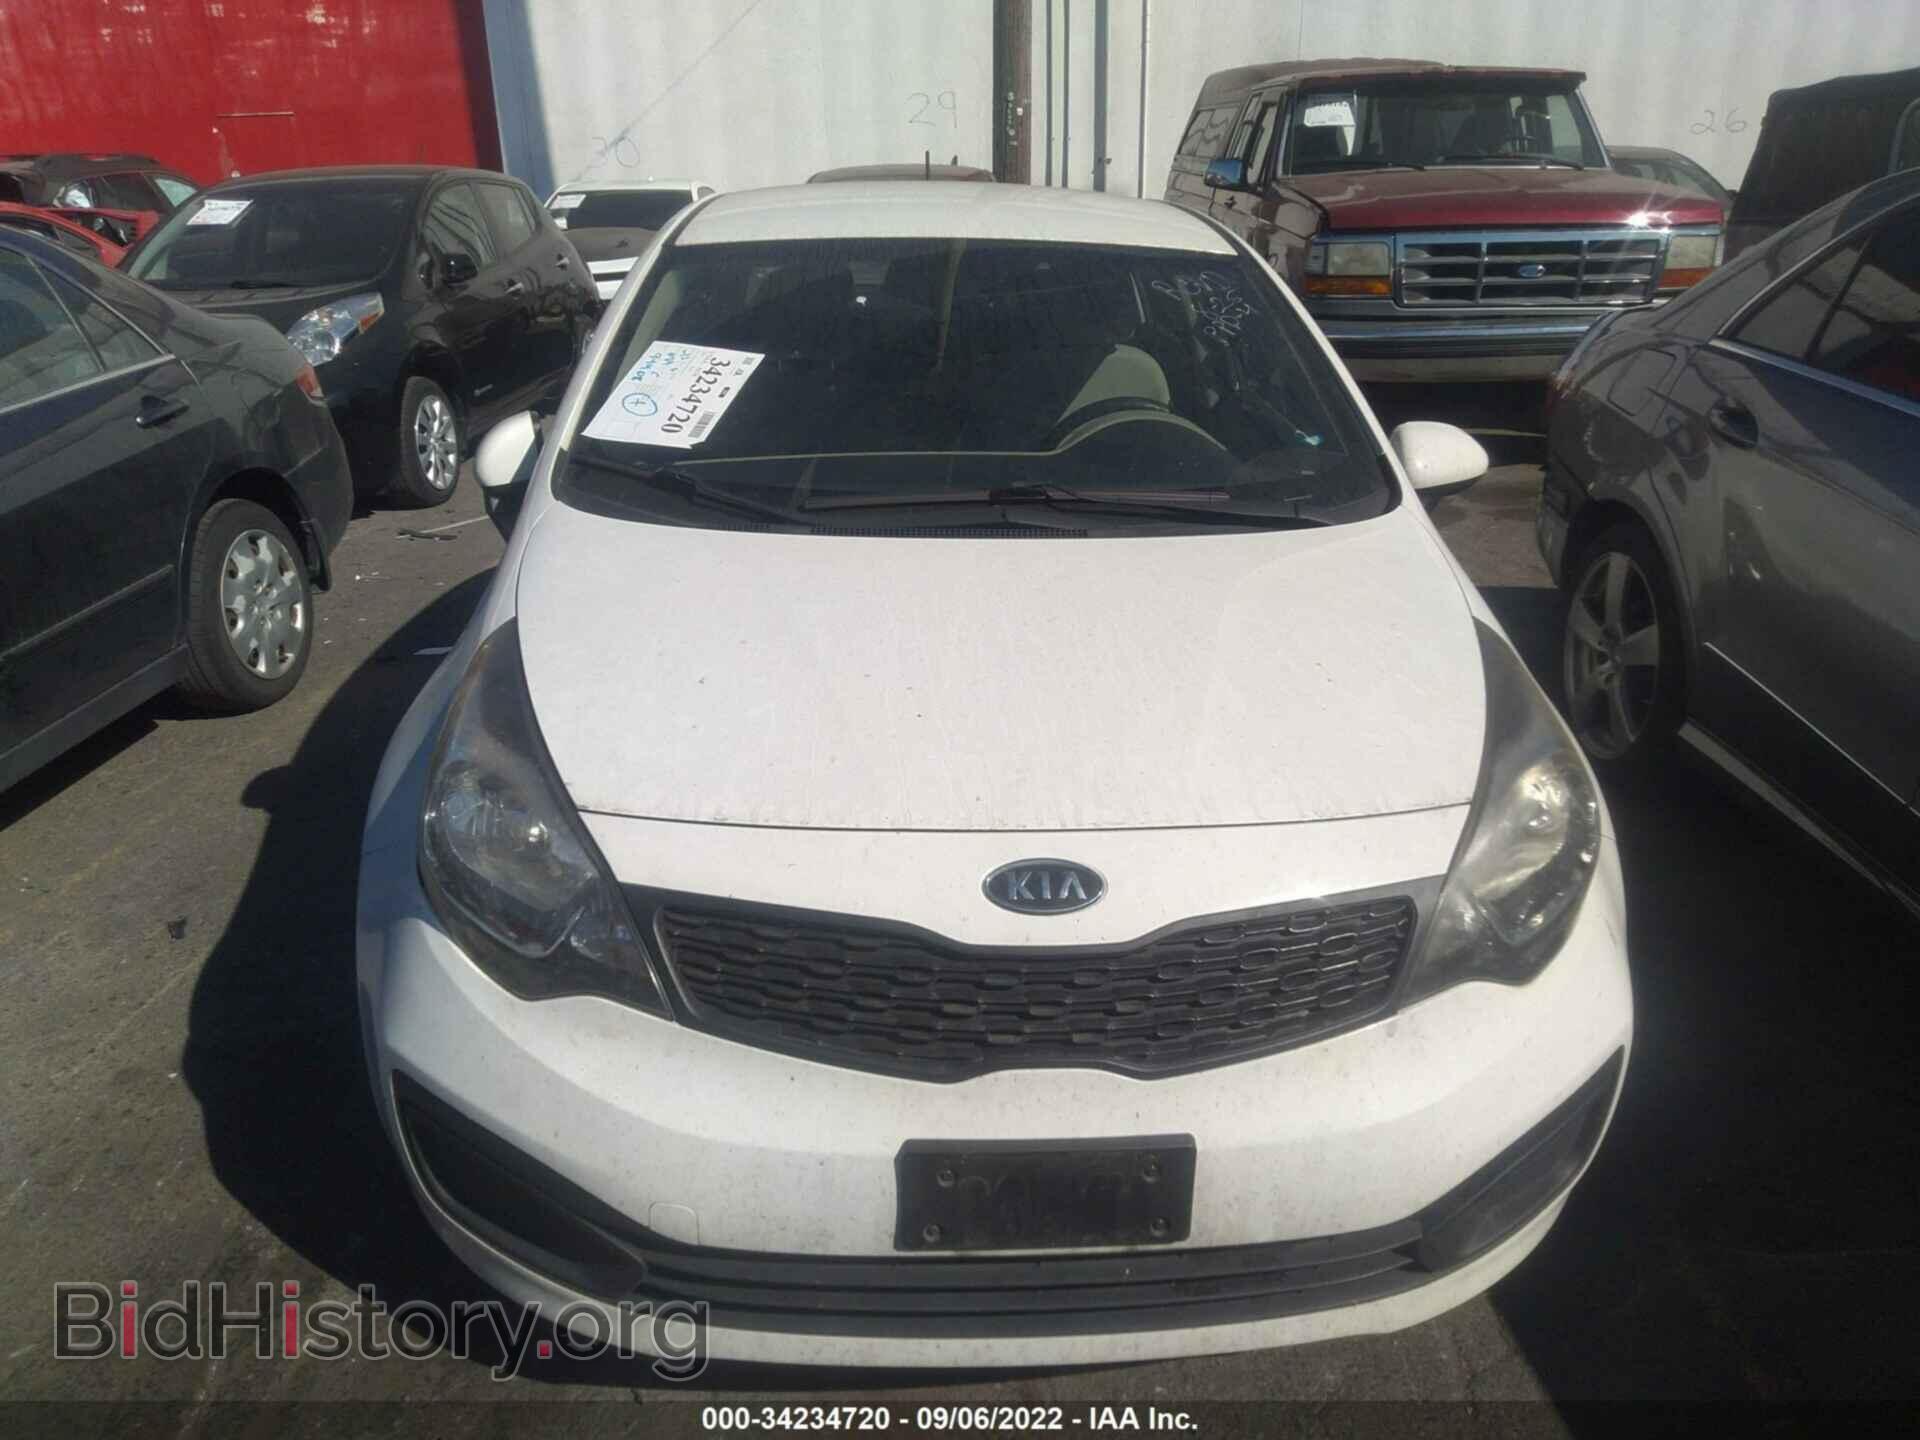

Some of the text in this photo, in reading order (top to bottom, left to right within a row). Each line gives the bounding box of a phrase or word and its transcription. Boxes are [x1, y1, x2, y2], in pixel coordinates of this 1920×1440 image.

[904, 91, 959, 129] 29
[1688, 106, 1749, 136] 26
[660, 356, 731, 435] 34234720
[1007, 870, 1089, 900] KIA
